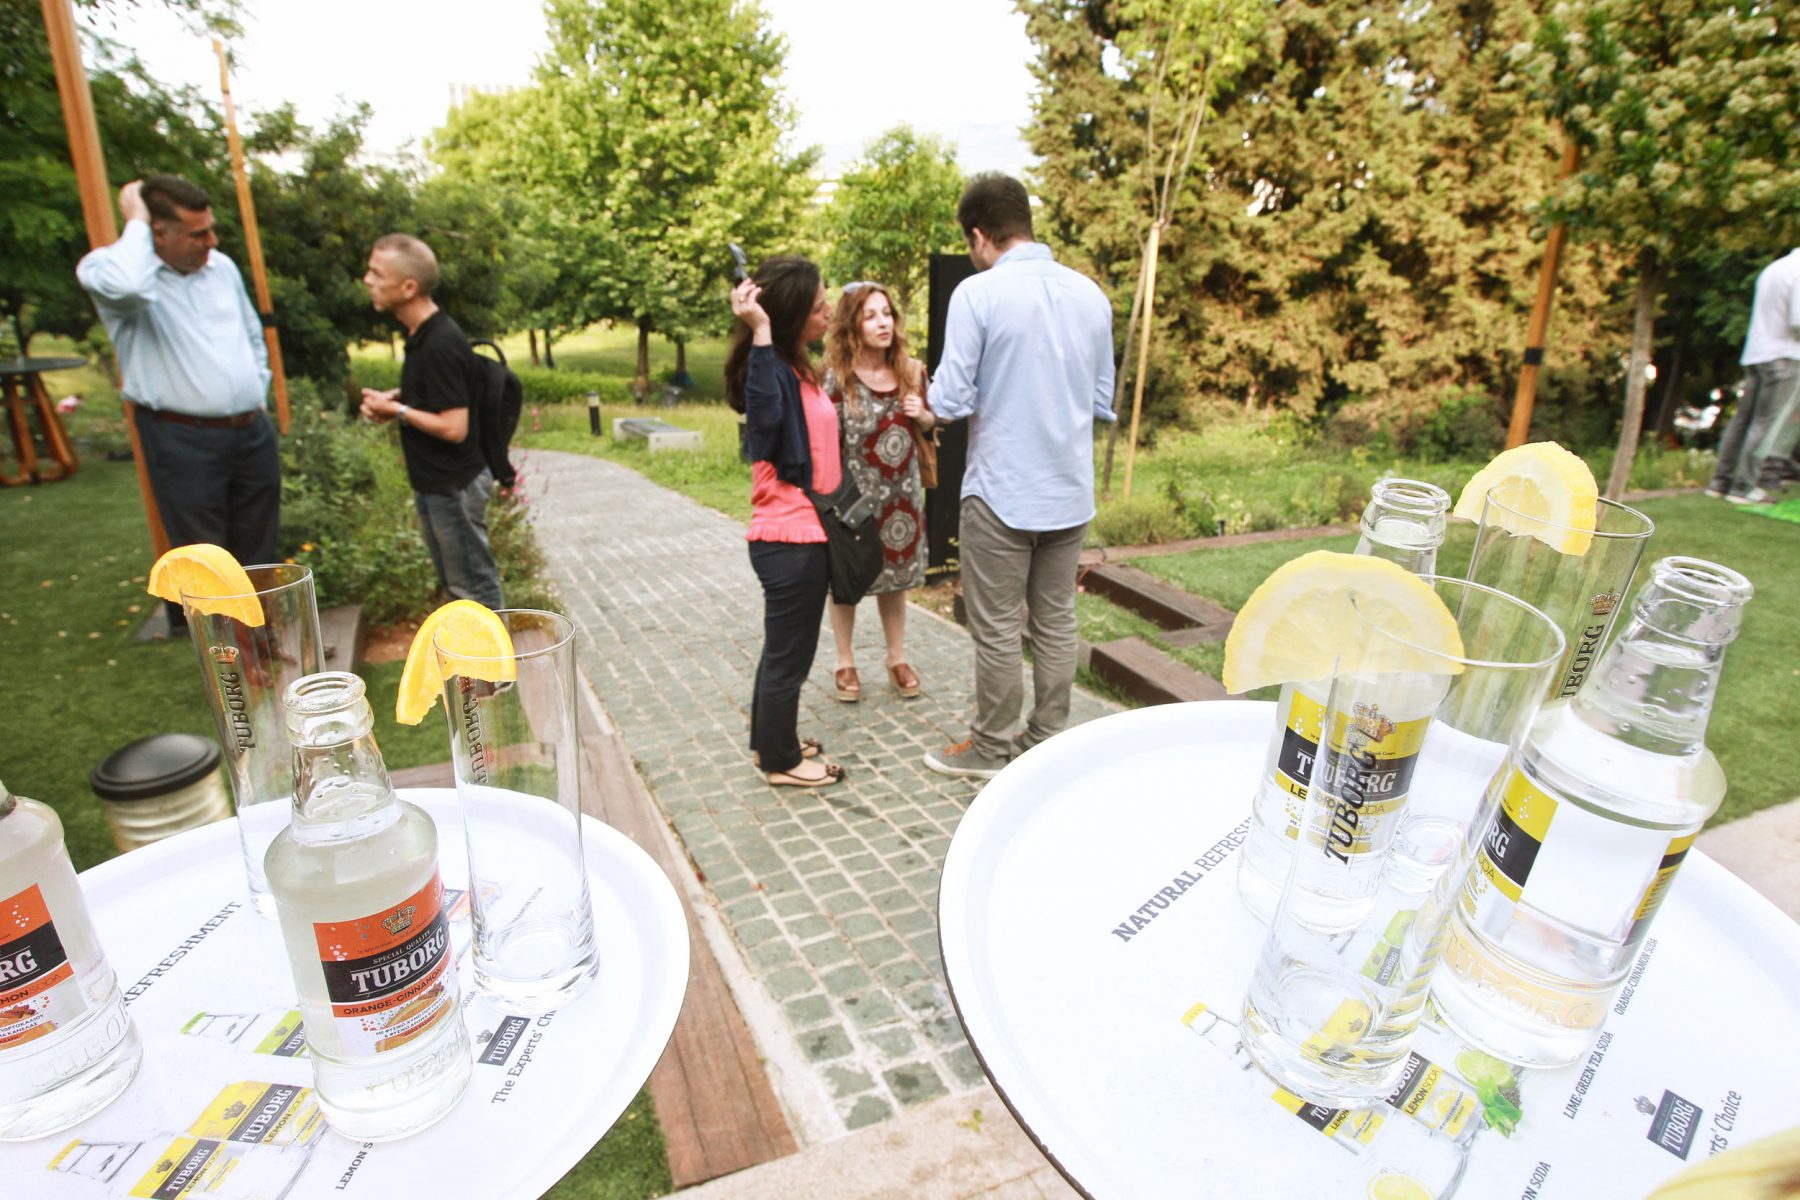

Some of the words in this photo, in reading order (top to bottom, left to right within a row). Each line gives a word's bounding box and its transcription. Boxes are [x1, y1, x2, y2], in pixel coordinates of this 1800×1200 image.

[1561, 624, 1605, 698] BORG
[220, 672, 256, 753] TUBORG
[1324, 742, 1377, 866] TUBORG
[1111, 870, 1204, 942] NATURAL
[1193, 816, 1252, 872] REFRES
[351, 926, 445, 993] TUBORG
[372, 948, 404, 965] SPECIAL
[1380, 951, 1399, 980] TUBORG
[1643, 937, 1658, 955] SODA
[487, 1018, 525, 1062] TUBORG
[1588, 1050, 1605, 1067] TEA
[1596, 1031, 1613, 1051] SODA
[491, 1079, 516, 1104] The
[506, 1029, 543, 1077] Experts'
[1404, 1087, 1429, 1116] LEMON
[1563, 1065, 1597, 1120] LIME-GREEN
[1713, 1090, 1742, 1132] Choice
[240, 1088, 293, 1143] TUBORG
[263, 1113, 292, 1143] LEMON
[1661, 1099, 1695, 1152] TUBORG
[166, 1147, 209, 1193] TUBORG
[335, 1150, 367, 1191] LEMON
[1529, 1161, 1551, 1189] SODA
